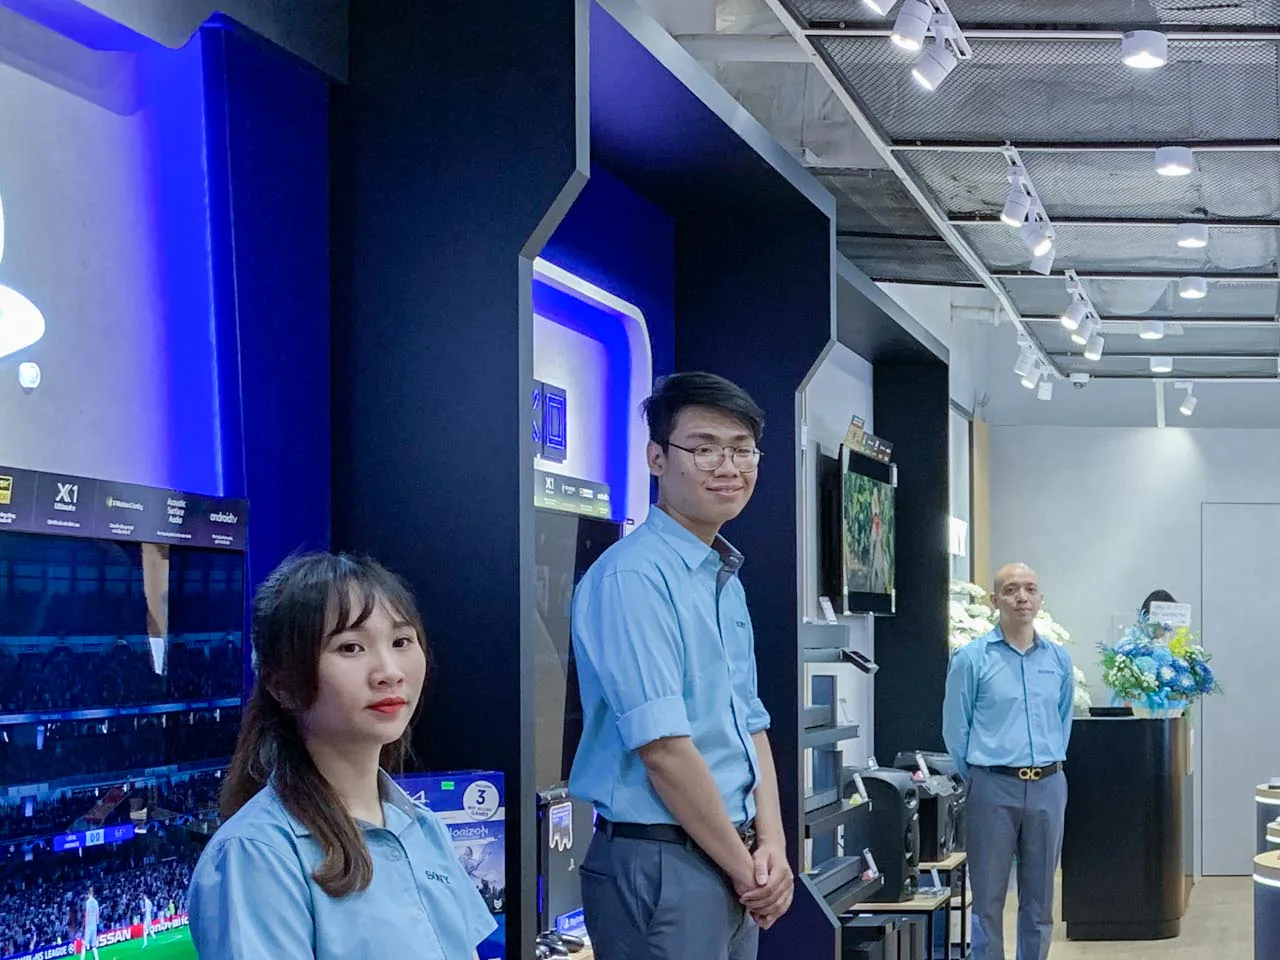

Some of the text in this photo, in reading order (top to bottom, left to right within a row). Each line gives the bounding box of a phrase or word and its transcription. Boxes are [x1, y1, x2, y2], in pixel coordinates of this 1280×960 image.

[55, 482, 79, 503] X1
[476, 789, 486, 805] 3
[44, 945, 68, 960] LEAGUE
